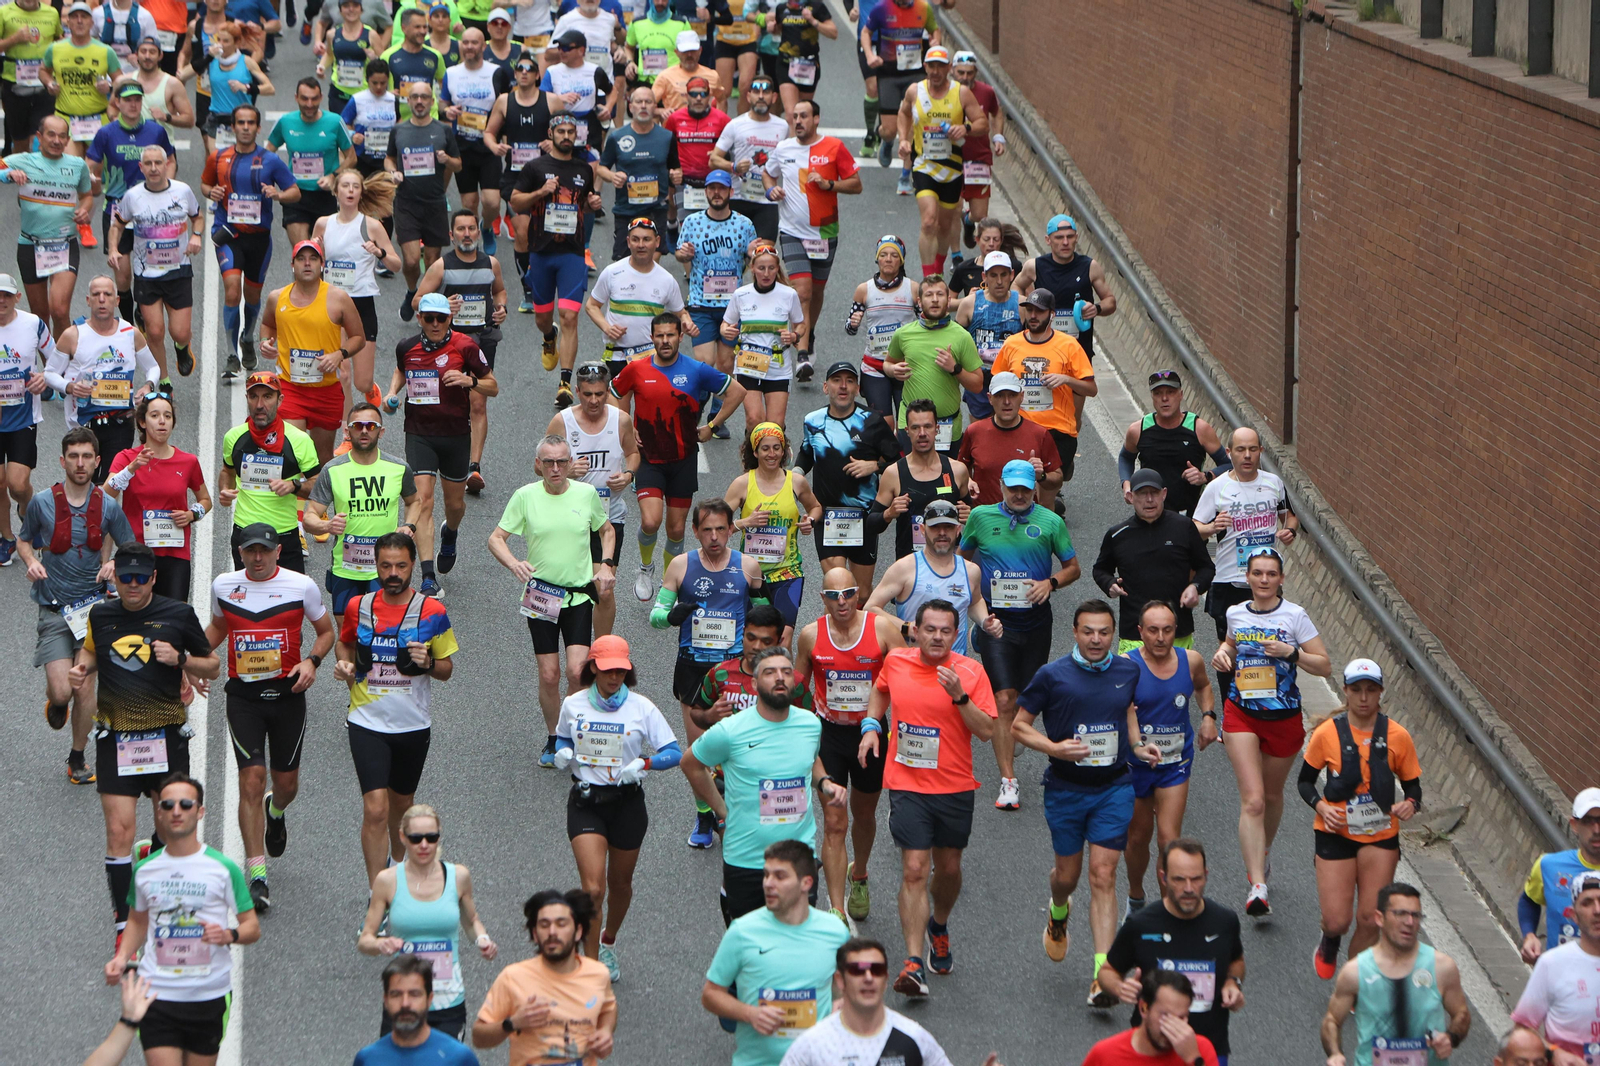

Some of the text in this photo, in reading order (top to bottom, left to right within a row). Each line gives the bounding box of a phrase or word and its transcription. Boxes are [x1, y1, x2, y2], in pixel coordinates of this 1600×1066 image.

[926, 111, 952, 119] CORRE
[810, 155, 829, 164] Cris
[33, 189, 71, 200] HILARIO
[702, 235, 734, 255] COMO
[878, 325, 898, 333] ZURICH
[256, 456, 279, 464] ZURICH
[350, 476, 386, 499] FW
[348, 498, 390, 513] FLOW
[1250, 537, 1272, 545] ZURICH
[537, 583, 561, 597] ZURICH
[1003, 583, 1018, 591] 8439
[74, 595, 98, 609] ZURICH
[534, 596, 548, 605] 6577
[531, 603, 548, 614] HARALD
[707, 610, 732, 618] ZURICH
[706, 623, 722, 631] 8680
[699, 632, 719, 640] ALBERTO
[248, 641, 275, 650] ZURICH
[249, 656, 265, 664] 4704
[381, 654, 397, 662] ZUR
[1244, 658, 1270, 666] ZURICH
[840, 671, 867, 679] ZURICH
[368, 678, 411, 686] ADRIAN&CLAUDIA
[839, 685, 857, 693] 9263
[591, 724, 619, 732] ZURICH
[908, 727, 935, 736] ZURICH
[1089, 724, 1114, 732] ZURICH
[1155, 725, 1181, 733] ZURICH
[590, 738, 608, 746] 8363
[907, 740, 923, 749] 9673
[1154, 739, 1170, 747] 9049
[906, 750, 922, 758] Carlos
[776, 779, 801, 788] ZURICH
[776, 795, 794, 803] 6798
[774, 807, 796, 815] SWA013
[172, 927, 204, 936] ZURICH
[416, 943, 447, 951] ZURICH
[1178, 962, 1209, 971] ZURICH
[778, 990, 811, 1000] ZURICH
[1389, 1039, 1422, 1049] ZURICH
